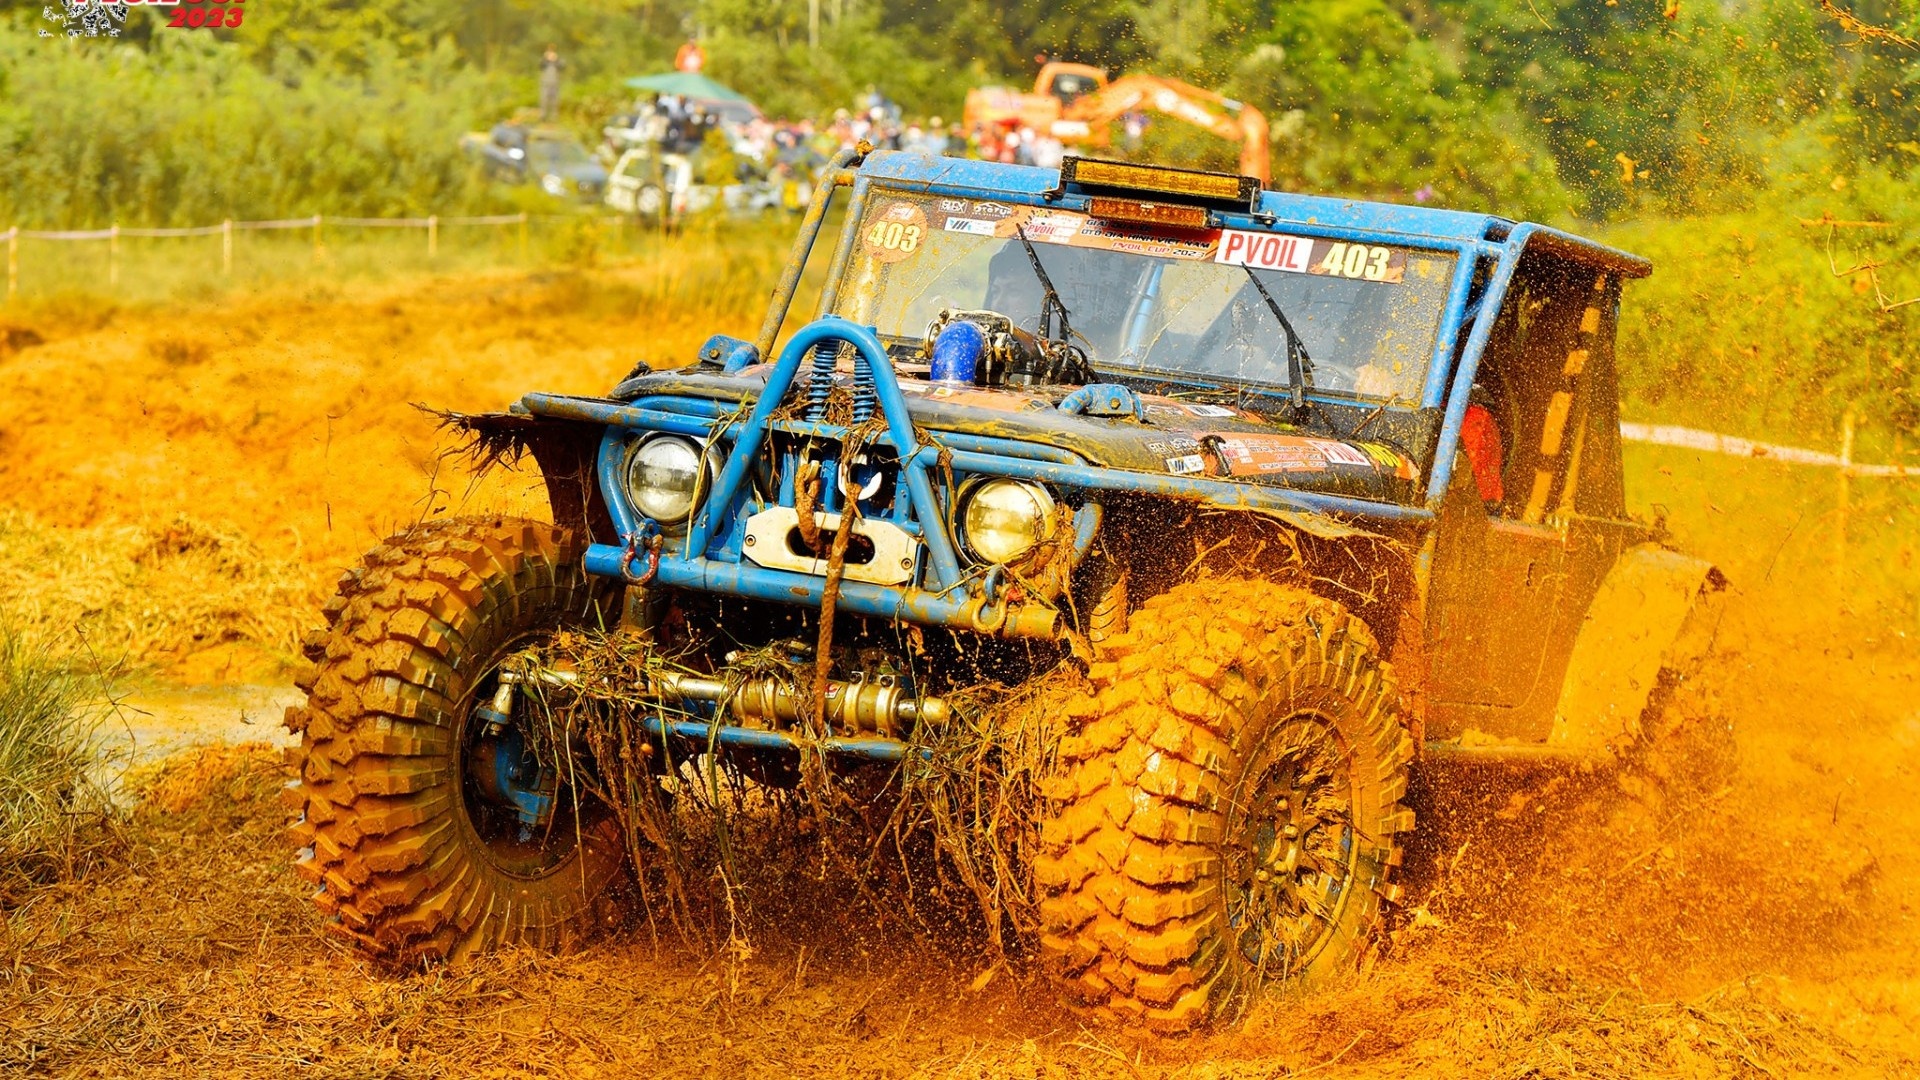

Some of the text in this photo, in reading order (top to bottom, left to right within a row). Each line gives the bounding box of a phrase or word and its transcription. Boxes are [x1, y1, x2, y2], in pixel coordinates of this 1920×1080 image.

[866, 220, 921, 253] 403
[1027, 224, 1056, 235] PVOIL
[1112, 242, 1205, 258] PVOIL CUP 2023
[1184, 239, 1211, 250] NAM
[1224, 233, 1298, 269] PVOIL
[1320, 242, 1391, 281] 403
